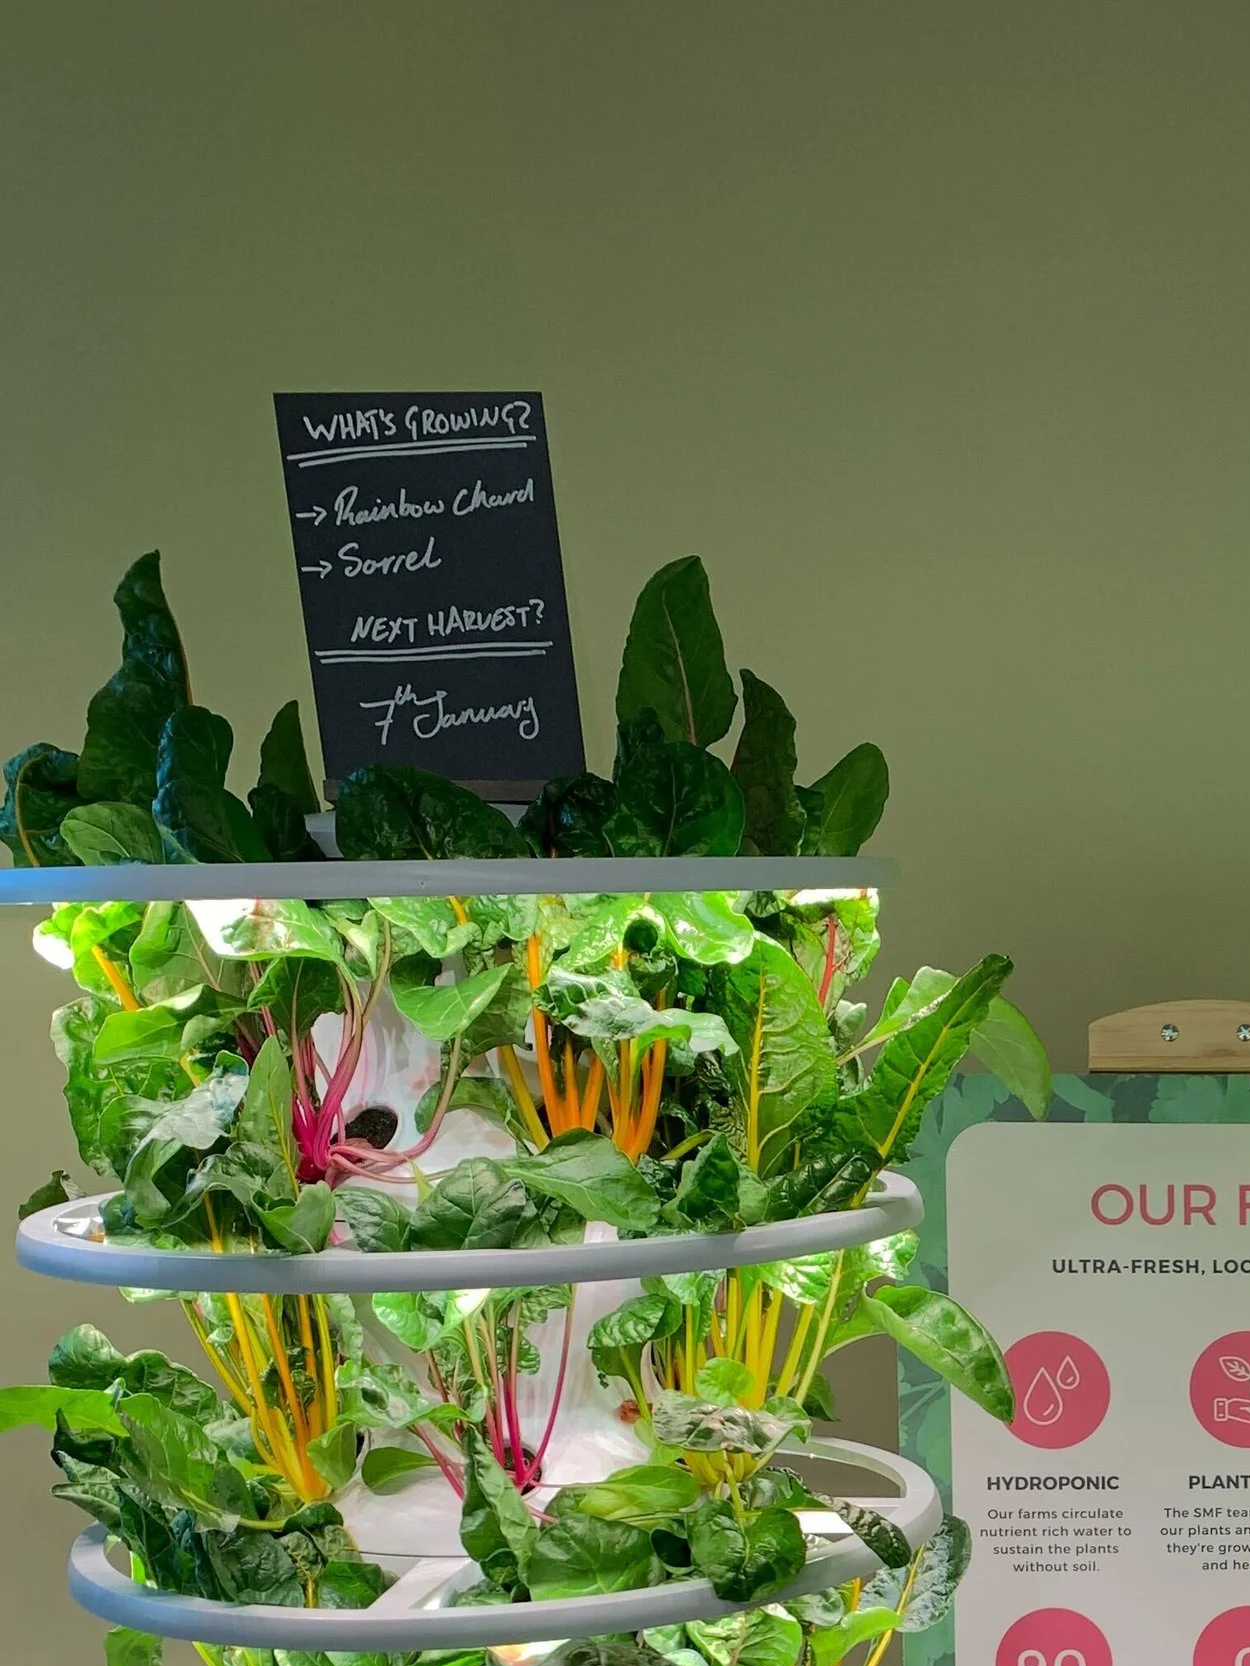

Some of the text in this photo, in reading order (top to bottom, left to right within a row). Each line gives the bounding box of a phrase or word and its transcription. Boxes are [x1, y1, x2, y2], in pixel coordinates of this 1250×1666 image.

[303, 401, 531, 441] WHAT'S GROWING?
[334, 479, 534, 526] Rainbow Chard
[338, 537, 442, 577] Sorrel
[351, 599, 545, 643] NEXT HARVEST?
[414, 690, 540, 739] January
[1091, 1184, 1217, 1226] OUR
[1052, 1259, 1205, 1276] ULTRA-FRESH,
[987, 1476, 1119, 1491] HYDROPONIC
[988, 1508, 1123, 1519] Our farms circulate
[1164, 1507, 1189, 1518] The
[1194, 1508, 1222, 1518] SMF
[980, 1526, 1132, 1537] nutrient rich water to
[1160, 1526, 1183, 1535] our
[1188, 1525, 1231, 1537] plants
[993, 1543, 1119, 1556] sustain the plants
[1167, 1543, 1214, 1555] they're
[1013, 1561, 1100, 1572] without soil.
[1202, 1560, 1228, 1570] and
